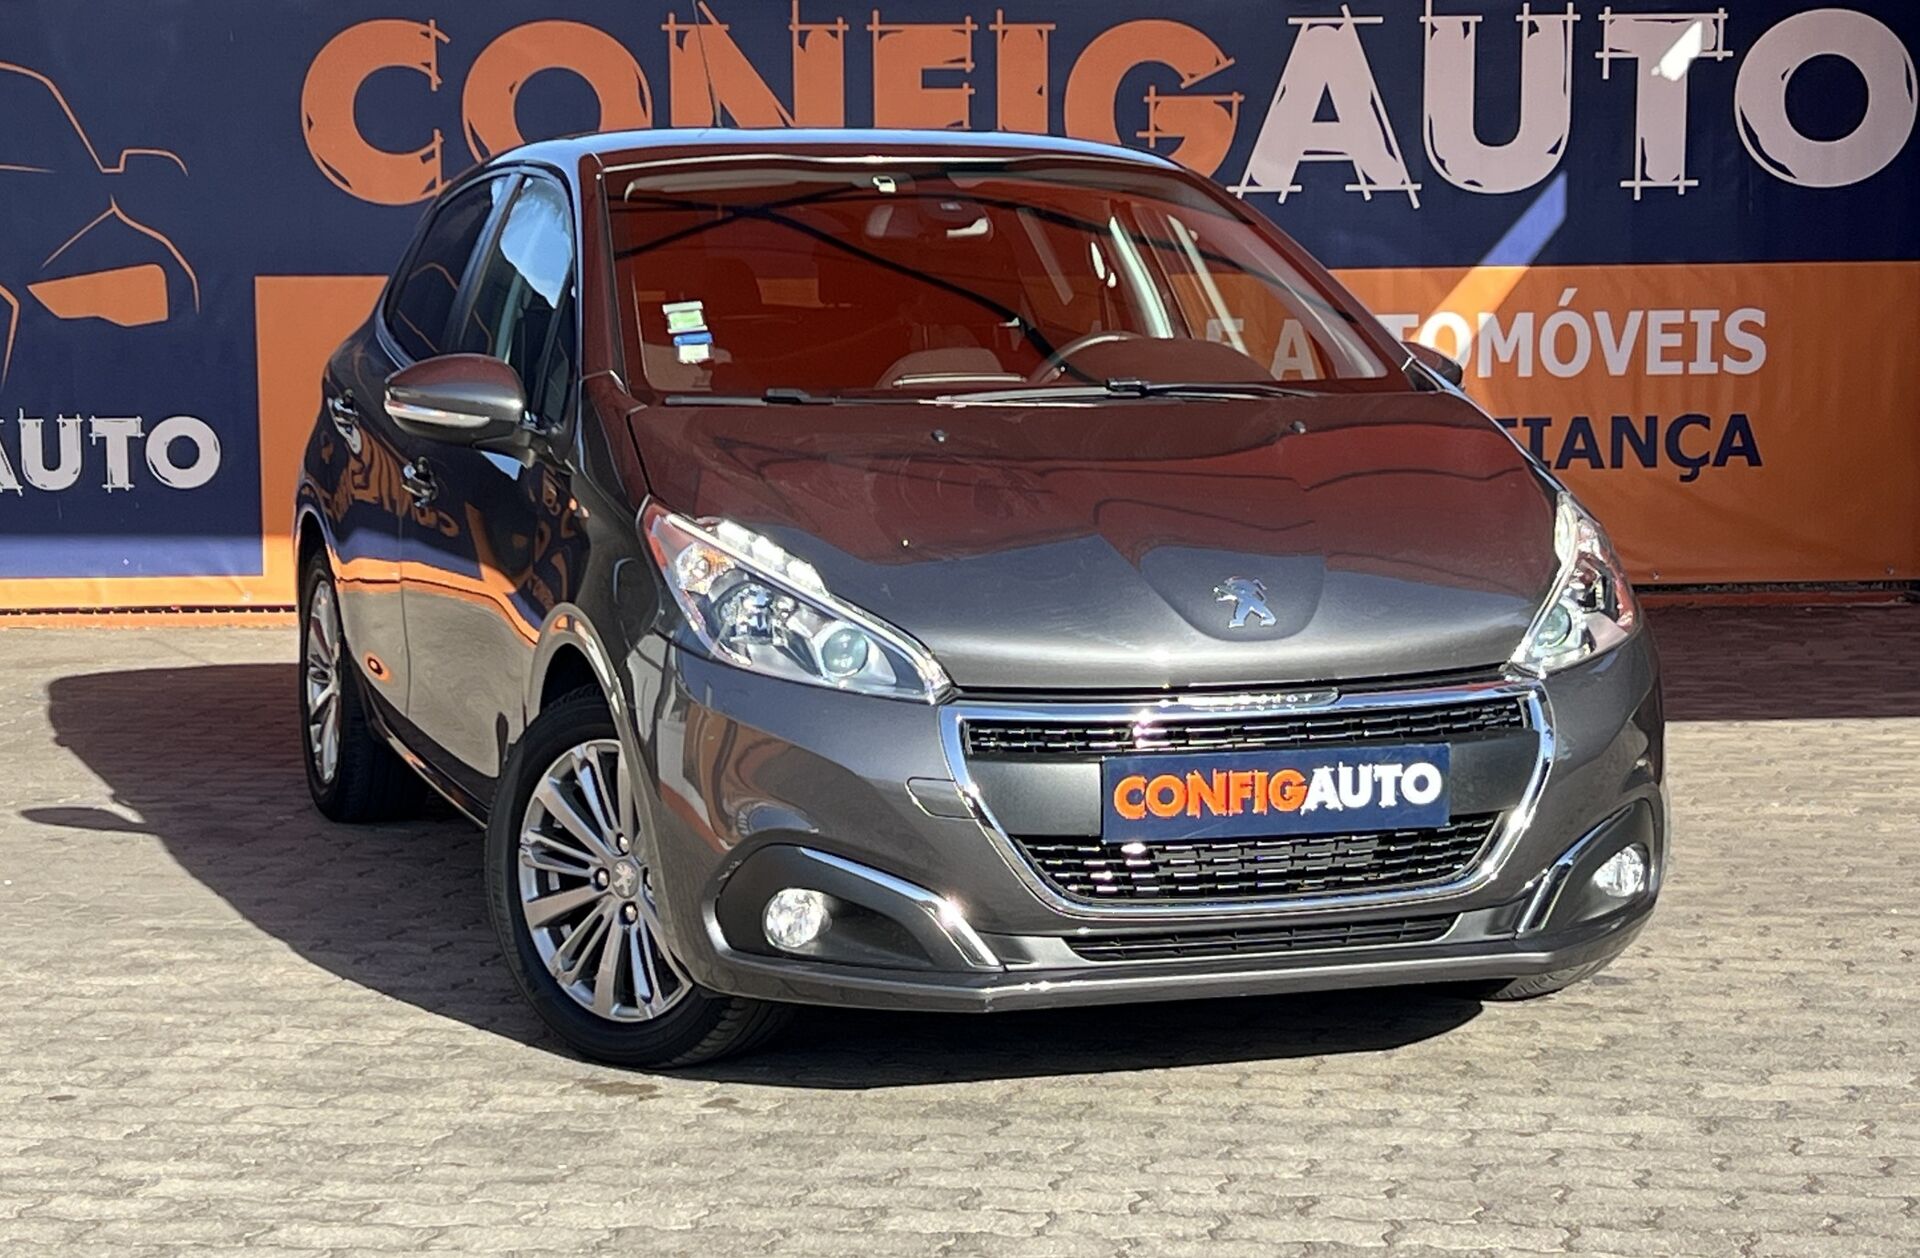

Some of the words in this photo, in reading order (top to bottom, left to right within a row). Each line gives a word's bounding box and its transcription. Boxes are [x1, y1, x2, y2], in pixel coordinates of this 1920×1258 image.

[301, 0, 1918, 208] CONFIGAUTO
[1495, 413, 1762, 482] IANÇA
[1113, 761, 1443, 820] CONFIGAUTO
